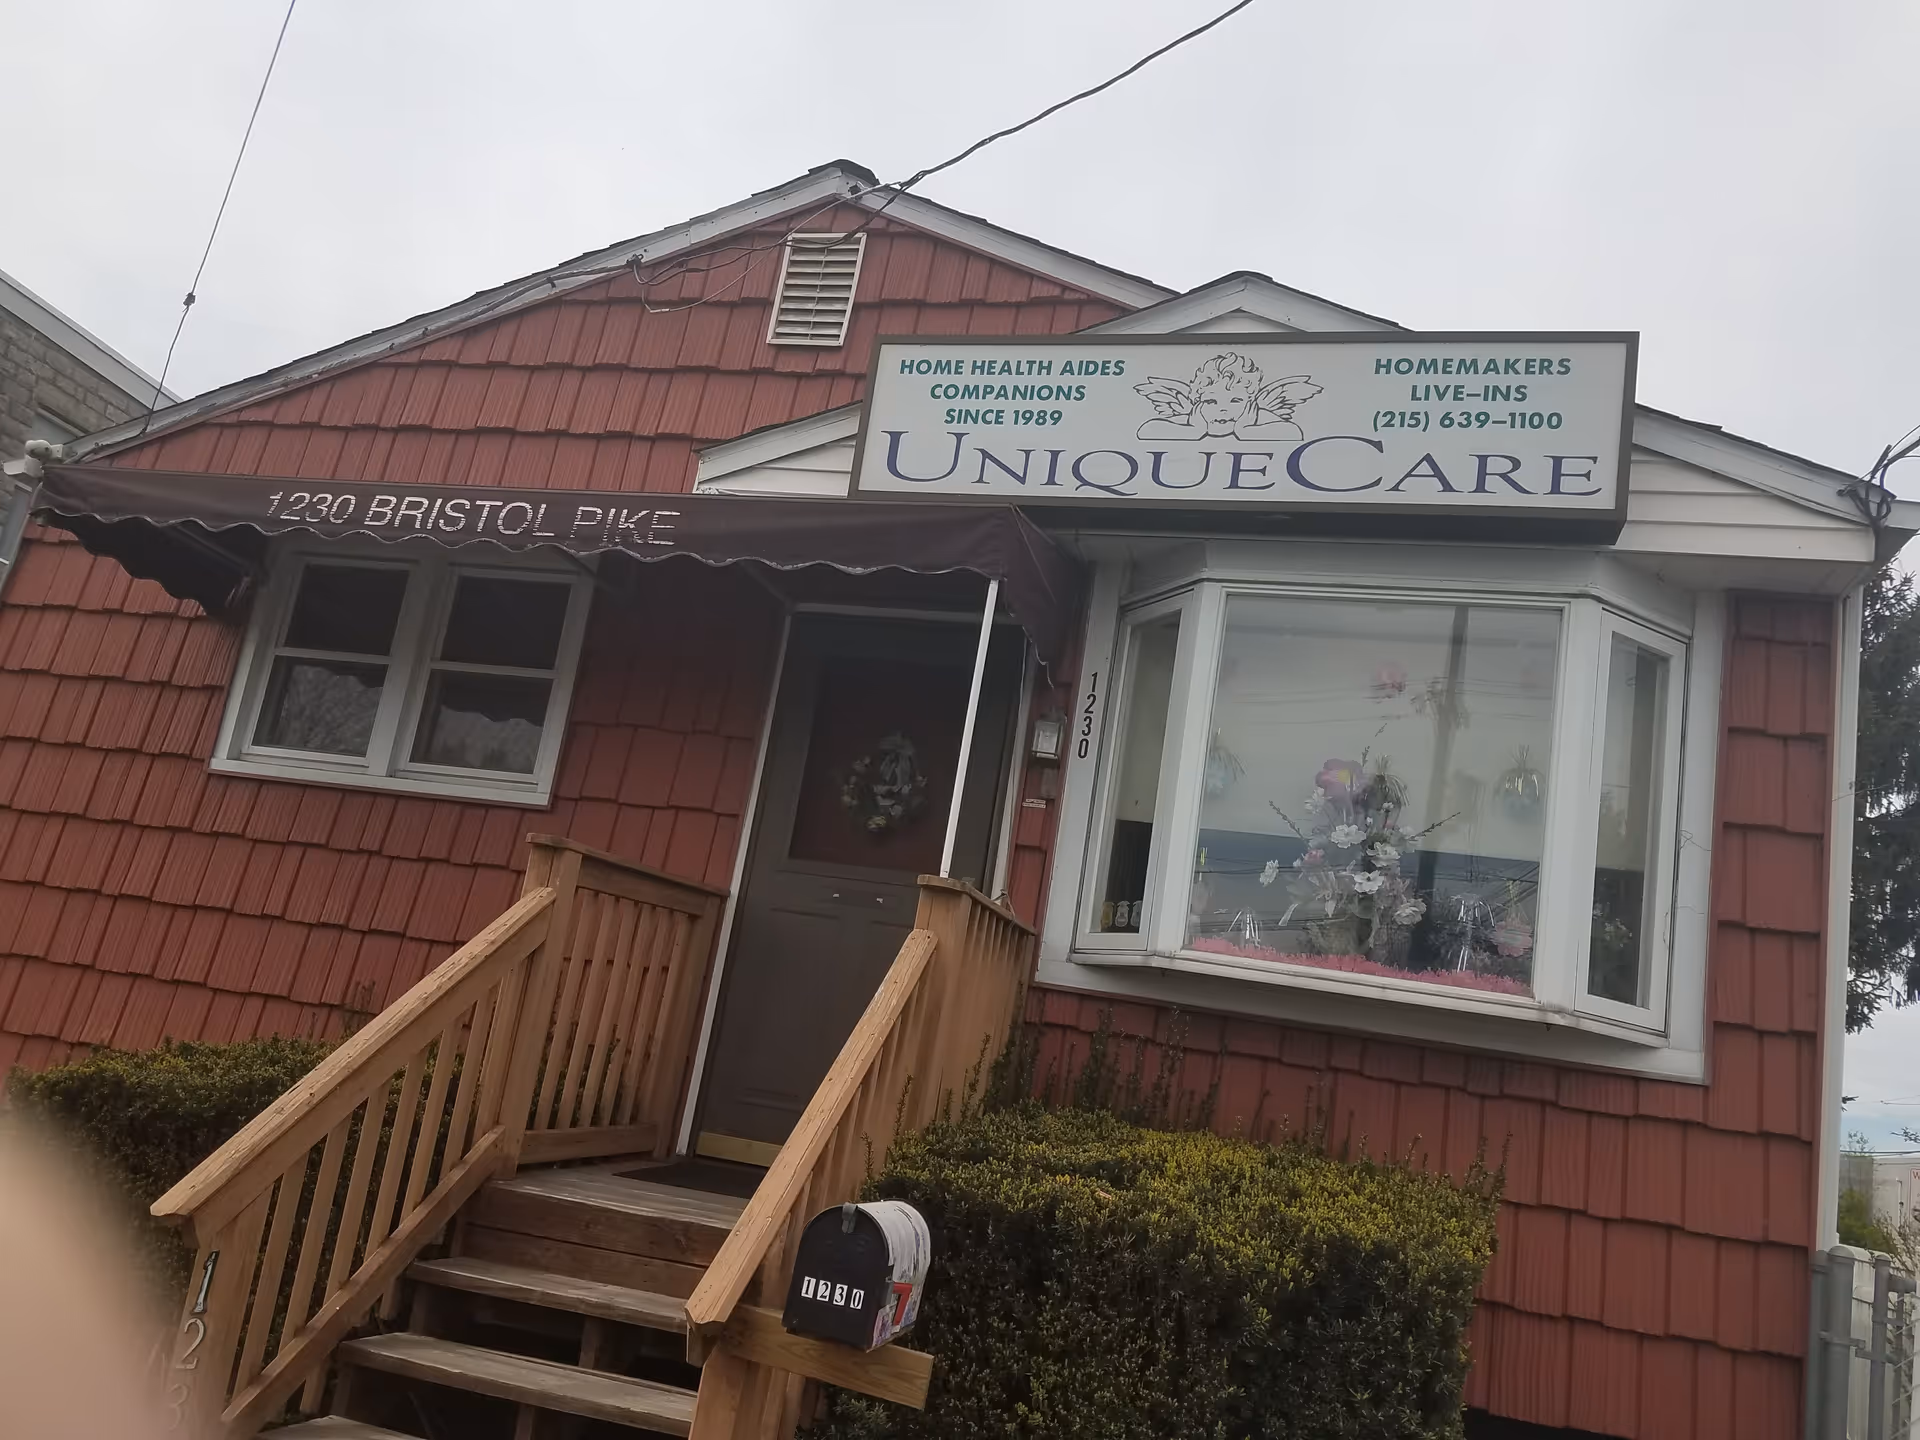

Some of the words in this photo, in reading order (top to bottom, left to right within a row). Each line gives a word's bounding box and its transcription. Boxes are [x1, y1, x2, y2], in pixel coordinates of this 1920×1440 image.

[899, 359, 965, 375] HOME
[970, 359, 1053, 376] HEALTH
[1059, 359, 1126, 376] AIDES
[1374, 358, 1572, 376] HOMEMAKERS
[930, 383, 1087, 401] COMPANIONS
[1410, 384, 1529, 402] LIVE-INS
[943, 408, 1005, 425] SINCE
[1012, 409, 1063, 426] 1989
[1372, 410, 1430, 432] (215)
[1439, 411, 1563, 430] 639-1100
[267, 491, 356, 524] 1230
[364, 495, 555, 537] BRISTOL
[569, 505, 681, 546] PIKE
[1077, 671, 1098, 758] 1230
[802, 1278, 863, 1308] 1230
